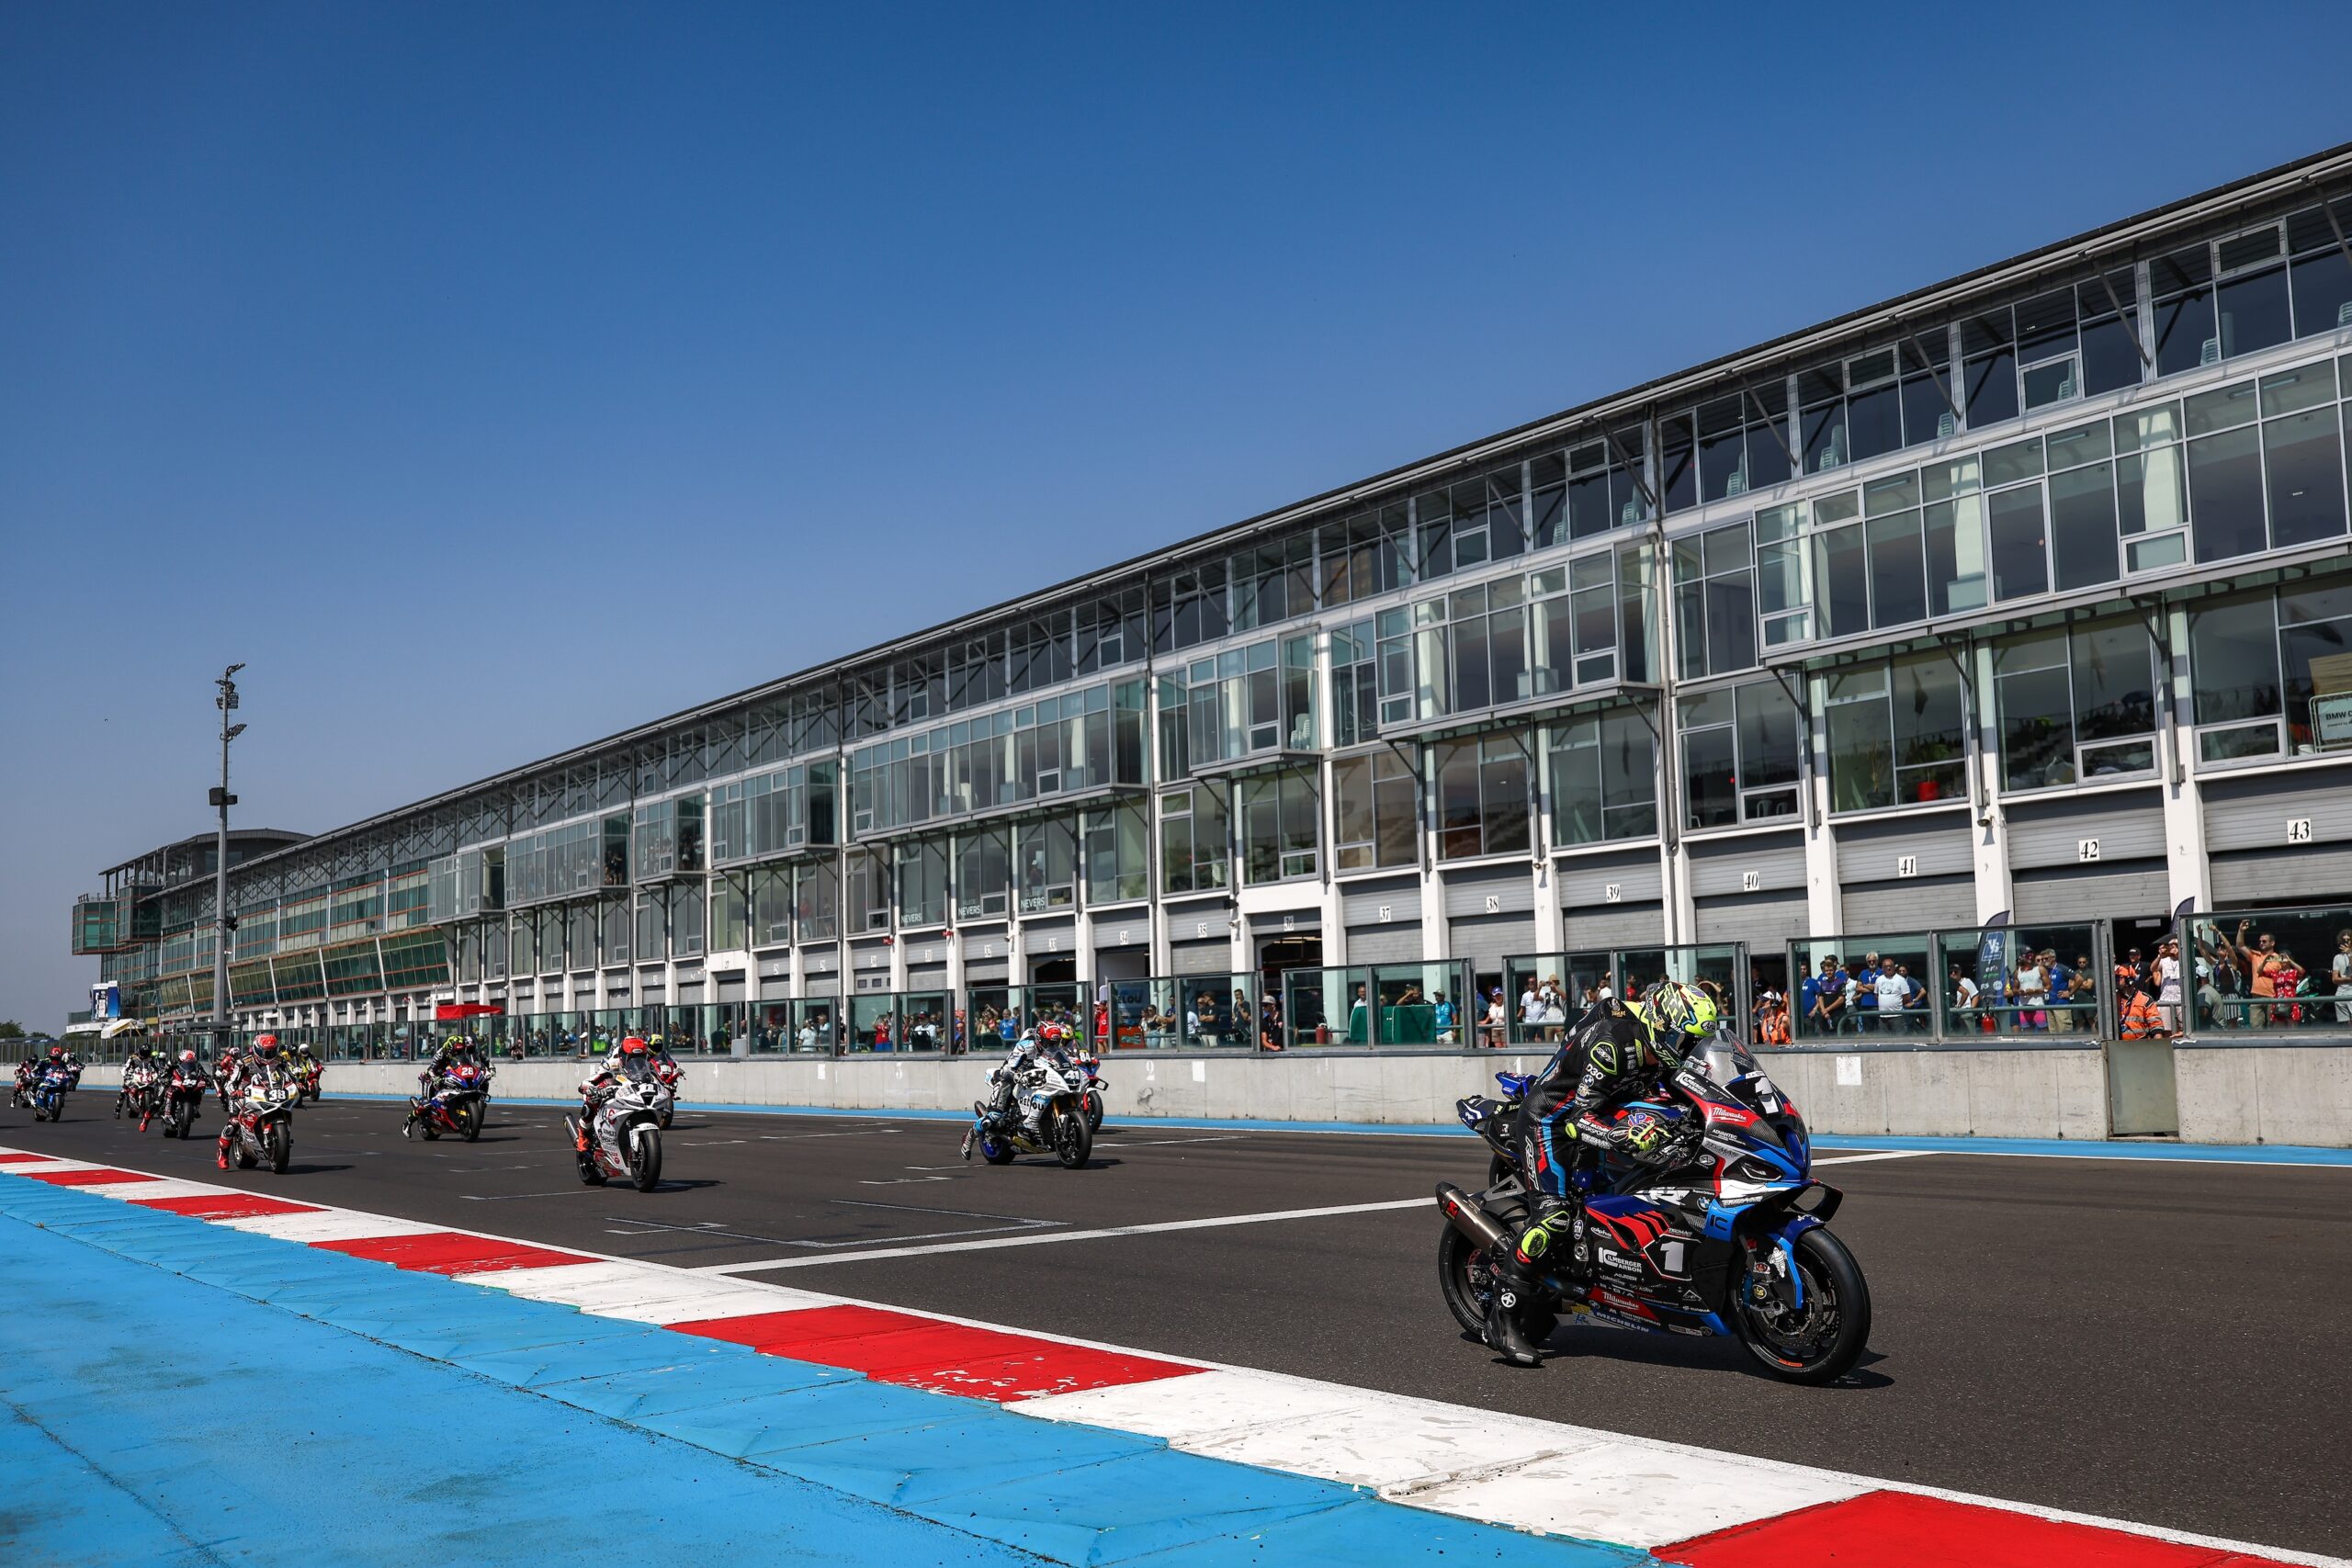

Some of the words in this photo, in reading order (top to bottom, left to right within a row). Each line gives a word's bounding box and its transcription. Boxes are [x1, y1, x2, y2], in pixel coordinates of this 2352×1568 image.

[2325, 711, 2346, 720] BMW
[2290, 821, 2310, 840] 43
[2080, 841, 2098, 859] 42
[1900, 858, 1915, 874] 41
[1745, 873, 1758, 889] 40
[1607, 886, 1620, 900] 39
[1021, 897, 1045, 908] NEVERS
[1487, 897, 1498, 911] 38
[958, 905, 980, 916] NEVERS
[1380, 908, 1390, 920] 37
[900, 913, 922, 923] NEVERS
[1080, 1052, 1091, 1062] 84
[461, 1067, 474, 1076] 28
[1064, 1070, 1080, 1079] 41
[1586, 1063, 1604, 1080] D3O
[268, 1089, 286, 1100] 38
[1713, 1107, 1747, 1122] Milwaukee
[1577, 1122, 1607, 1137] MOTORSPORT
[1712, 1129, 1737, 1140] ADVANTEC
[1607, 1254, 1642, 1269] ILMBERGER
[1660, 1241, 1684, 1272] 1
[1602, 1292, 1639, 1310] Milwaukee
[1597, 1312, 1650, 1333] MICHELIN
